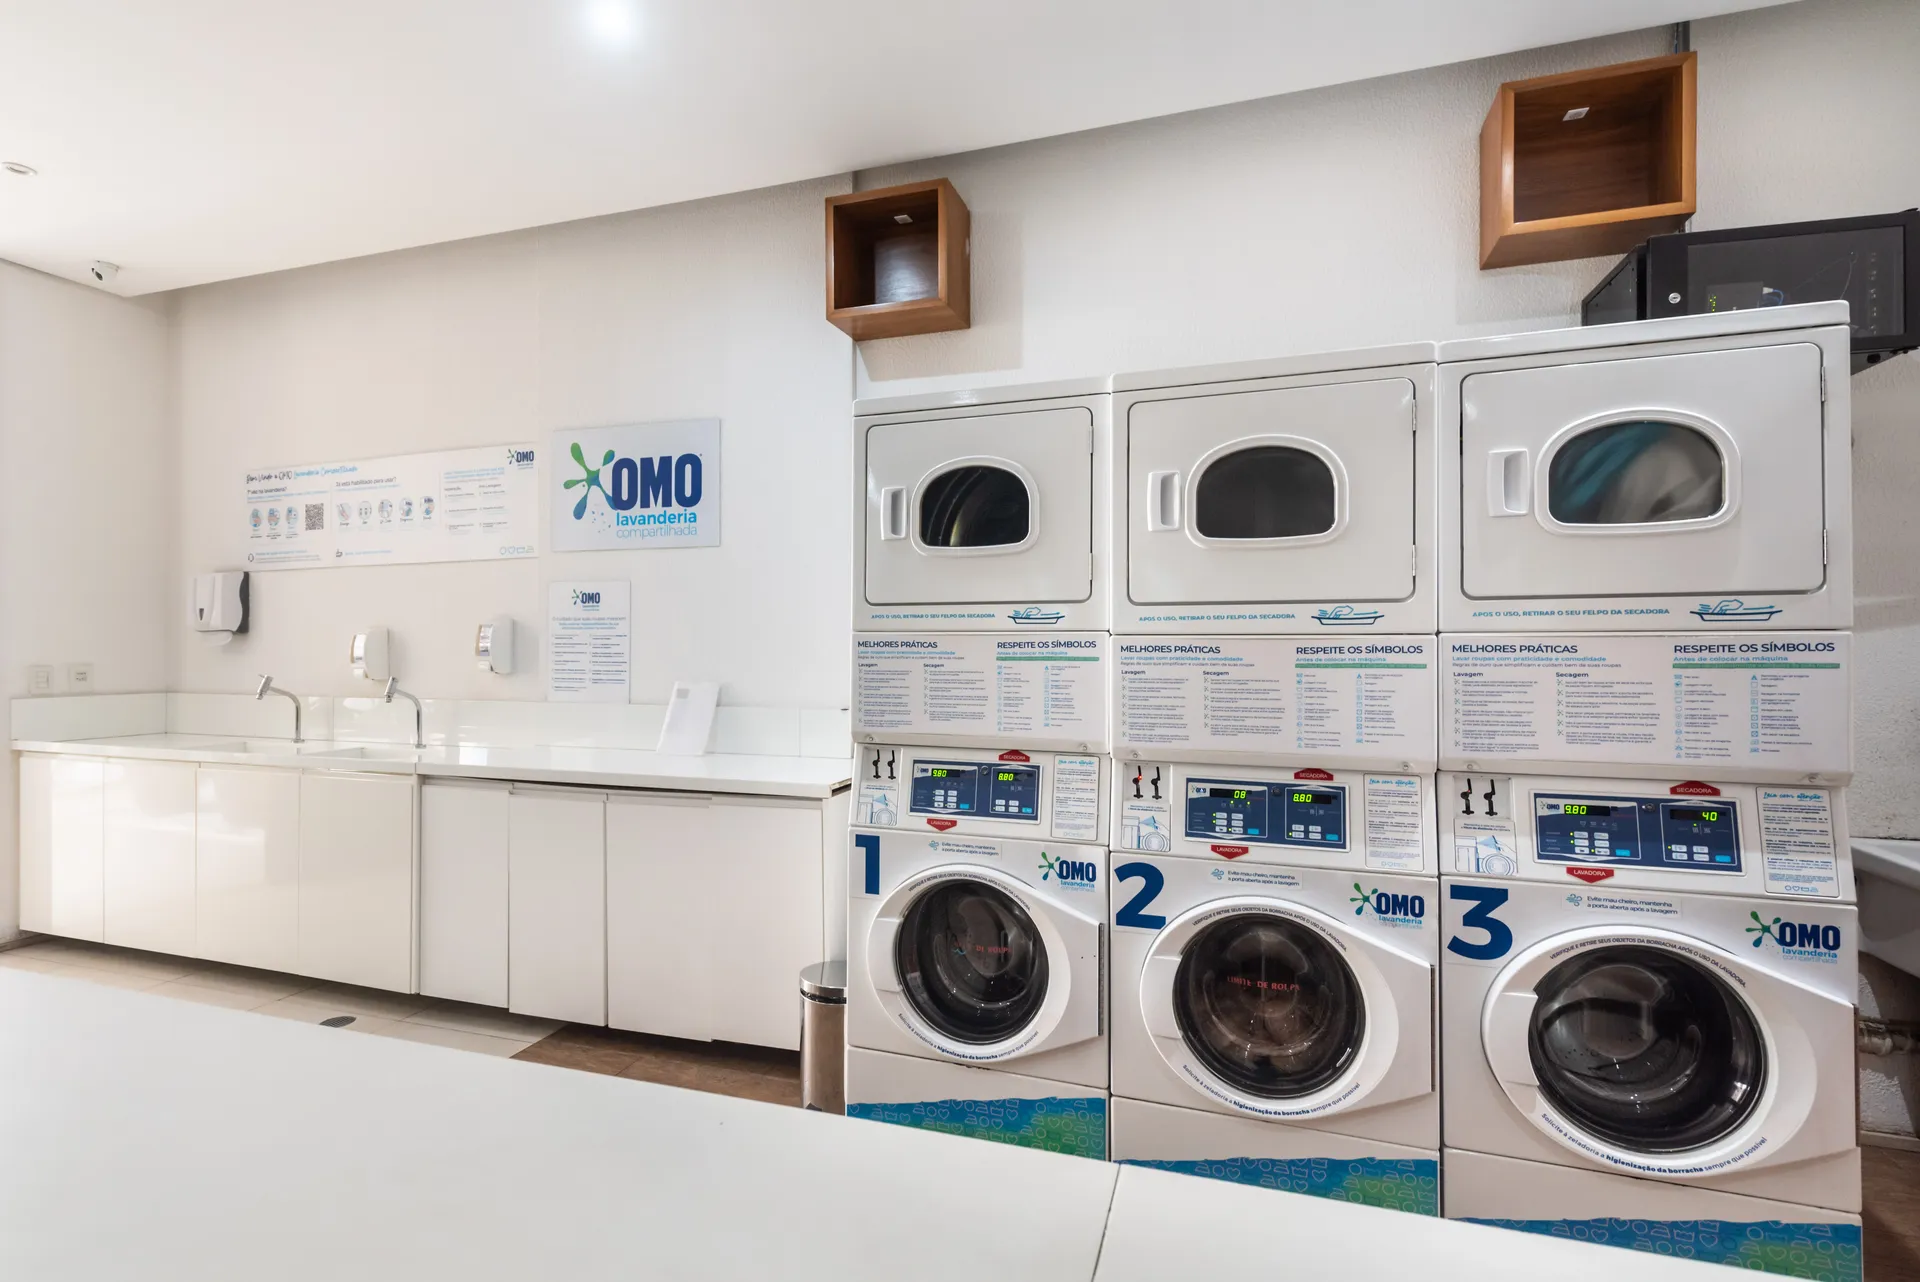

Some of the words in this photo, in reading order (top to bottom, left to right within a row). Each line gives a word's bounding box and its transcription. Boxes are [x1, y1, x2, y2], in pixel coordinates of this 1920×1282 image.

[516, 451, 534, 463] OMO
[612, 453, 702, 511] OMO
[616, 509, 697, 526] lavanderia
[616, 524, 697, 540] compartilhada
[582, 592, 601, 604] OMO
[900, 640, 938, 649] PRÁTICAS
[1037, 641, 1050, 649] OS
[1051, 639, 1097, 648] SÍMBOLOS
[1120, 645, 1173, 653] MELHORES
[1174, 644, 1221, 654] PRÁTICAS
[1296, 647, 1345, 655] RESPEITE
[1348, 646, 1363, 654] OS
[1365, 644, 1424, 654] SÍMBOLOS
[1452, 644, 1517, 653] MELHORES
[1520, 643, 1578, 654] PRÁTICAS
[1674, 644, 1736, 654] RESPEITE
[1739, 644, 1759, 653] OS
[1761, 641, 1835, 652] SÍMBOLOS
[1234, 790, 1247, 799] 08
[1702, 812, 1718, 821] 40
[855, 834, 880, 895] 1
[1059, 860, 1097, 883] OMO
[1061, 880, 1095, 889] lavanderia
[1114, 862, 1167, 930] 2
[1376, 893, 1425, 918] OMO
[1618, 898, 1639, 906] cheiro,
[1639, 900, 1673, 908] mantenha
[1651, 908, 1678, 916] lavagem
[1379, 915, 1423, 925] lavanderia
[1447, 884, 1514, 960] 3
[1779, 922, 1841, 951] OMO
[1550, 945, 1575, 960] VERIFIQUE
[1580, 940, 1597, 948] RETIRE
[1647, 939, 1677, 950] BORRACHA
[1678, 946, 1693, 955] APÓS
[1699, 953, 1711, 962] USO
[1711, 959, 1719, 967] DA
[1782, 947, 1838, 959] lavanderia
[1257, 981, 1269, 989] DE
[1204, 1083, 1229, 1102] zeladoria
[1234, 1100, 1273, 1116] higienização
[1310, 1102, 1332, 1113] sempre
[1332, 1097, 1343, 1106] que
[1542, 1113, 1564, 1134] Solicite
[1568, 1135, 1600, 1156] zeladoria
[1606, 1155, 1656, 1173] higienização
[1704, 1160, 1732, 1171] sempre
[1731, 1154, 1745, 1163] que
[1744, 1136, 1768, 1157] possível
